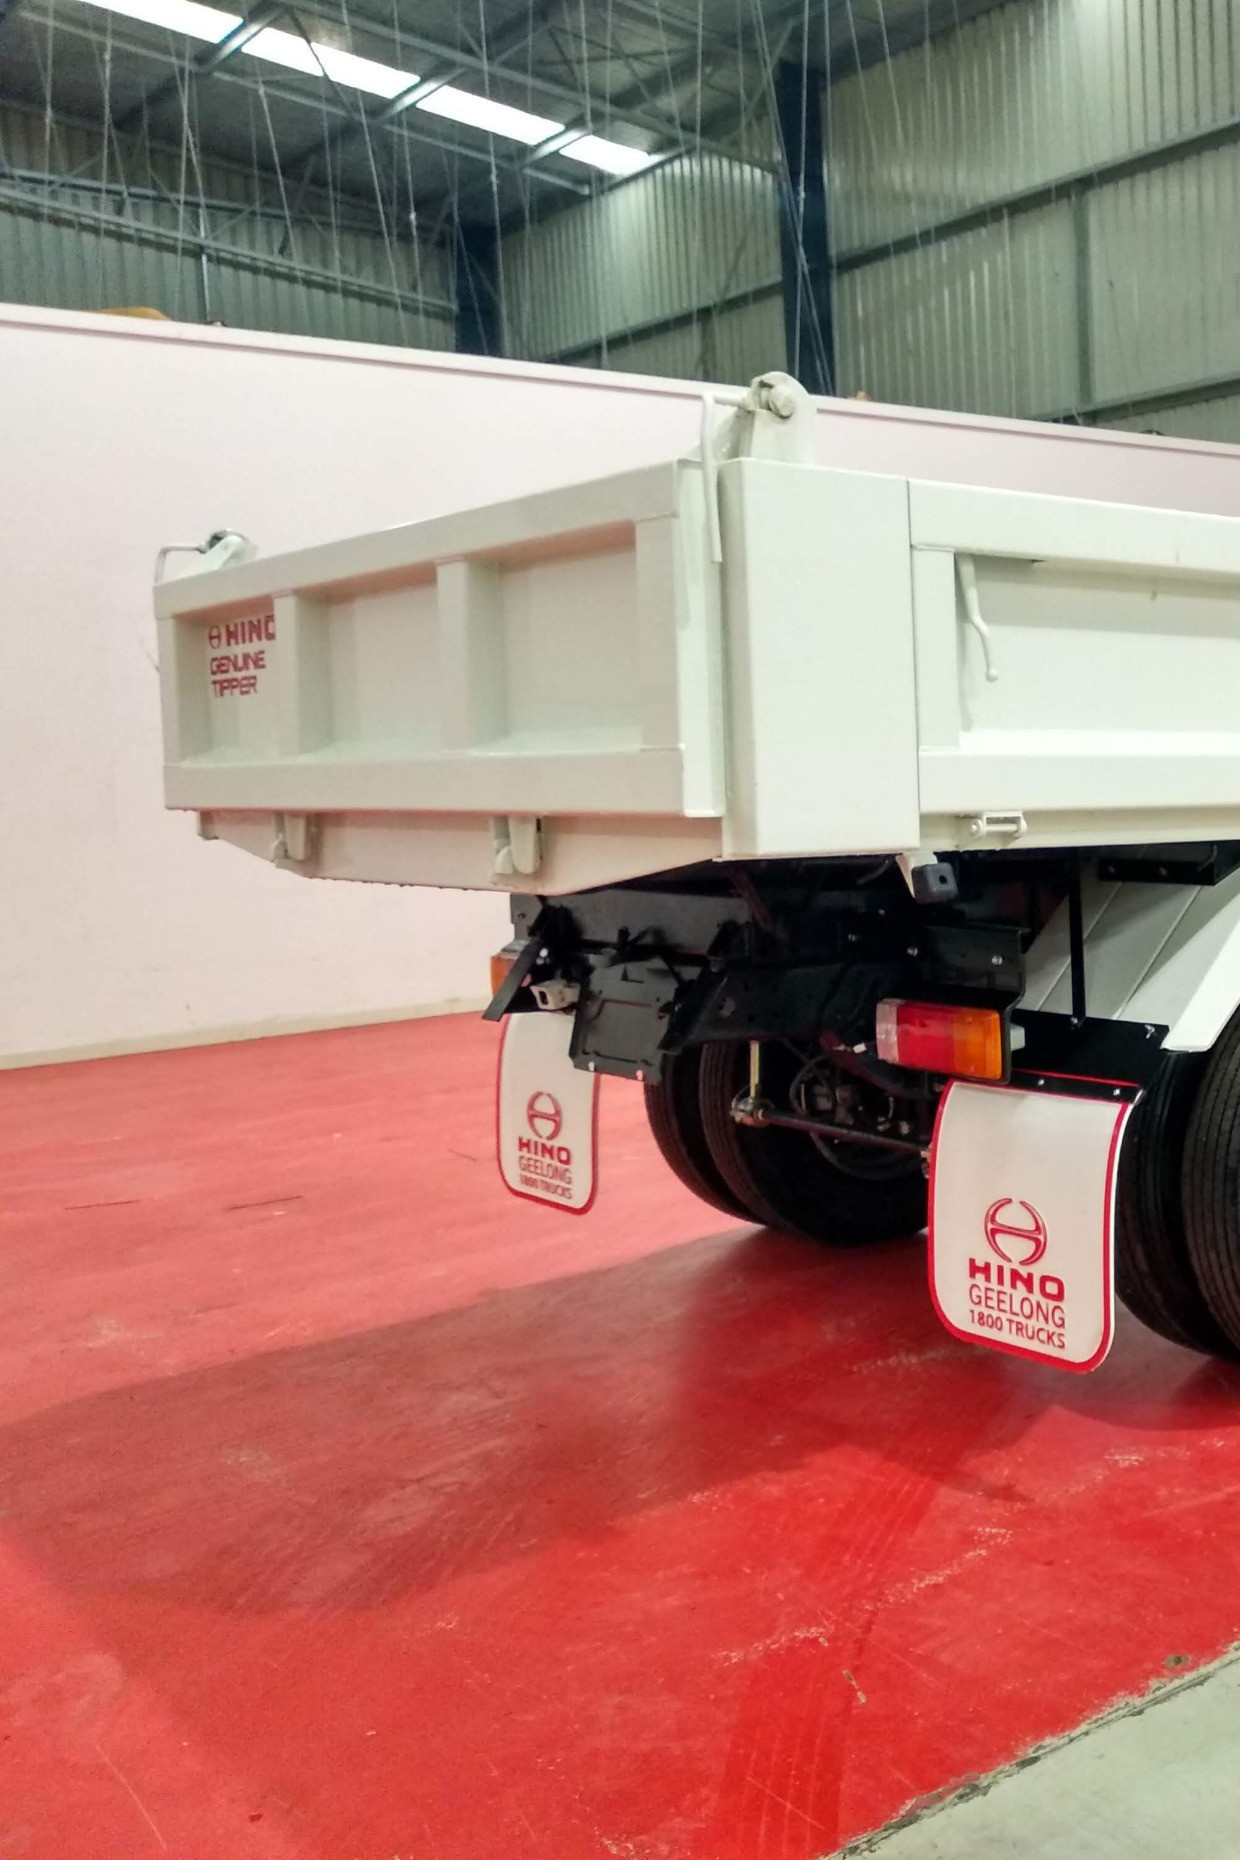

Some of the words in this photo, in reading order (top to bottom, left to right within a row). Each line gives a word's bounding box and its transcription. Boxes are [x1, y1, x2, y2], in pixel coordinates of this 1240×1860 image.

[226, 614, 276, 646] HINO
[210, 650, 266, 675] GENUINE
[211, 675, 258, 698] TIPPER
[518, 1136, 571, 1166] HINO
[519, 1155, 572, 1184] GEELONG
[968, 1258, 1065, 1302] HINO
[969, 1283, 1066, 1330] GEELONG
[969, 1309, 1003, 1332] 1800
[1006, 1318, 1066, 1349] TRUCKS
